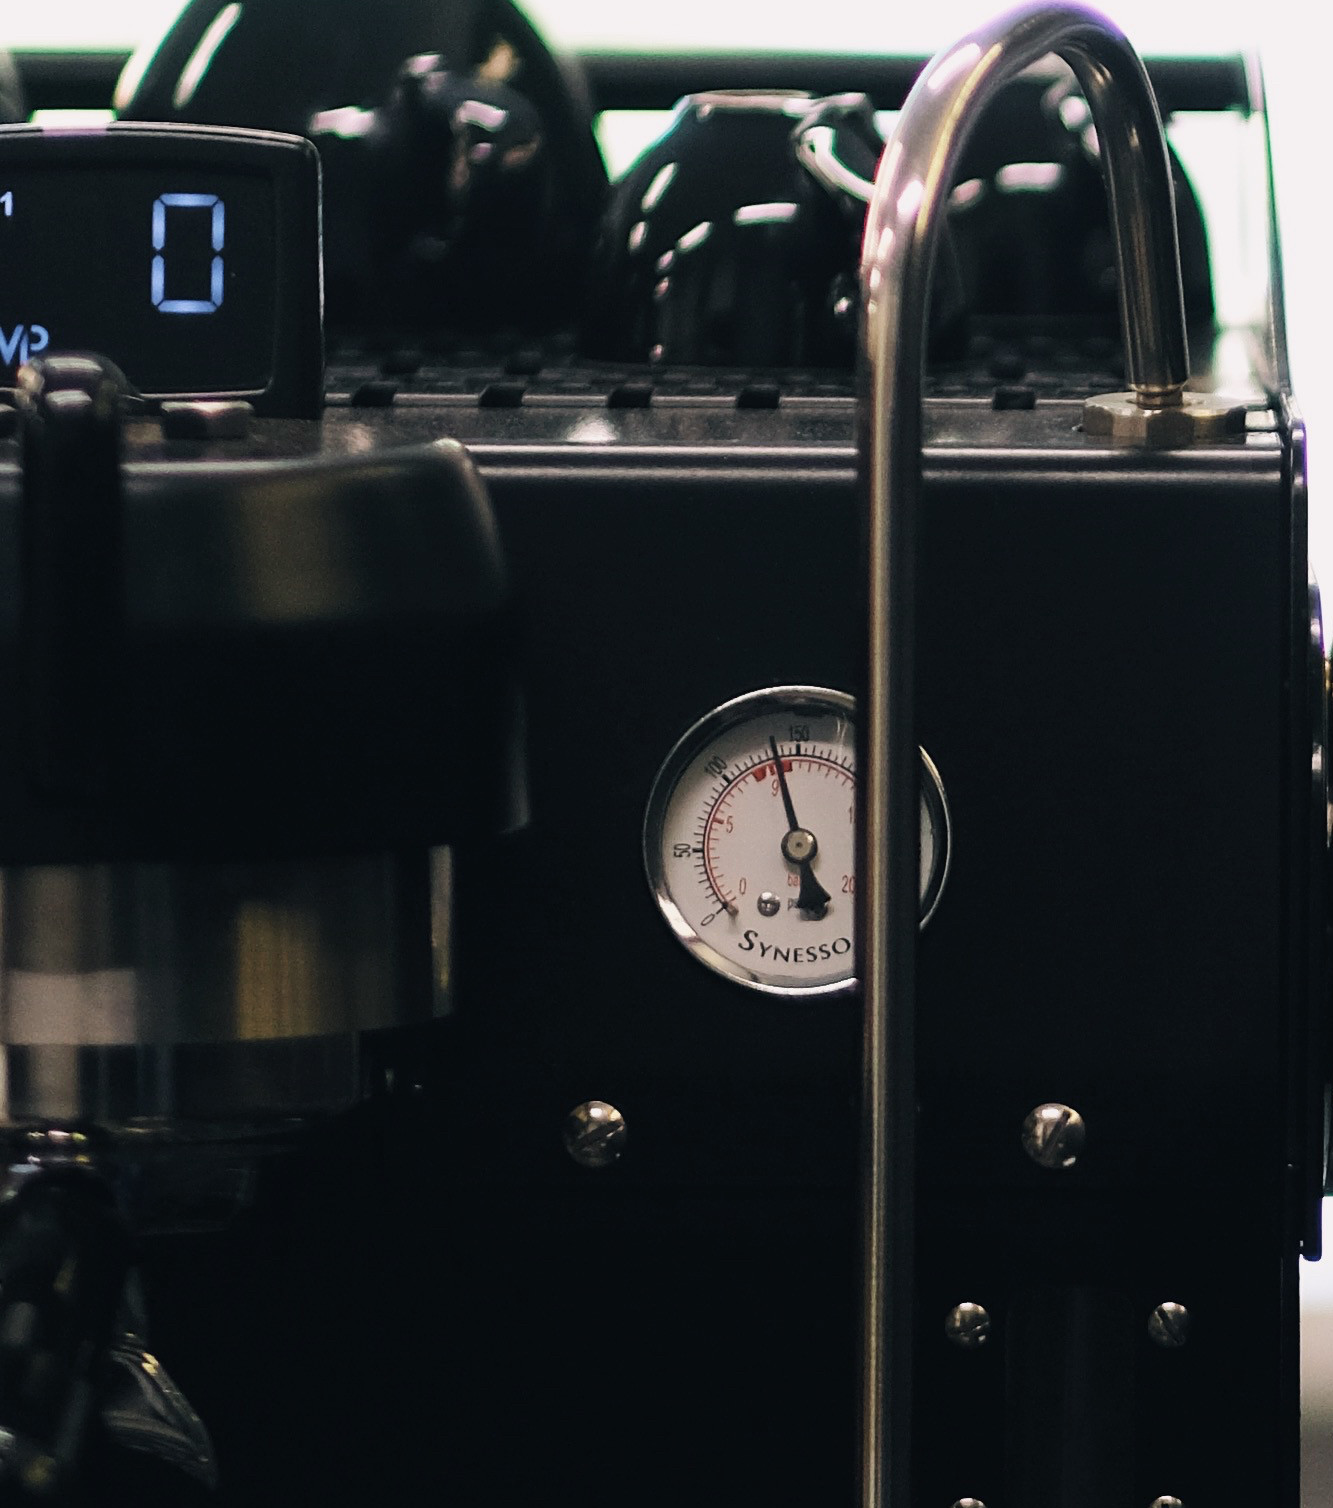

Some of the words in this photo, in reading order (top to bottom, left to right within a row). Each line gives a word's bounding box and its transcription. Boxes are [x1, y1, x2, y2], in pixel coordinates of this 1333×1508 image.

[151, 192, 225, 314] 0
[790, 725, 809, 741] 150
[704, 755, 728, 779] 100
[772, 779, 779, 797] 9
[726, 815, 734, 834] 5
[673, 843, 691, 858] 50
[739, 877, 747, 895] 0
[701, 913, 716, 926] 0
